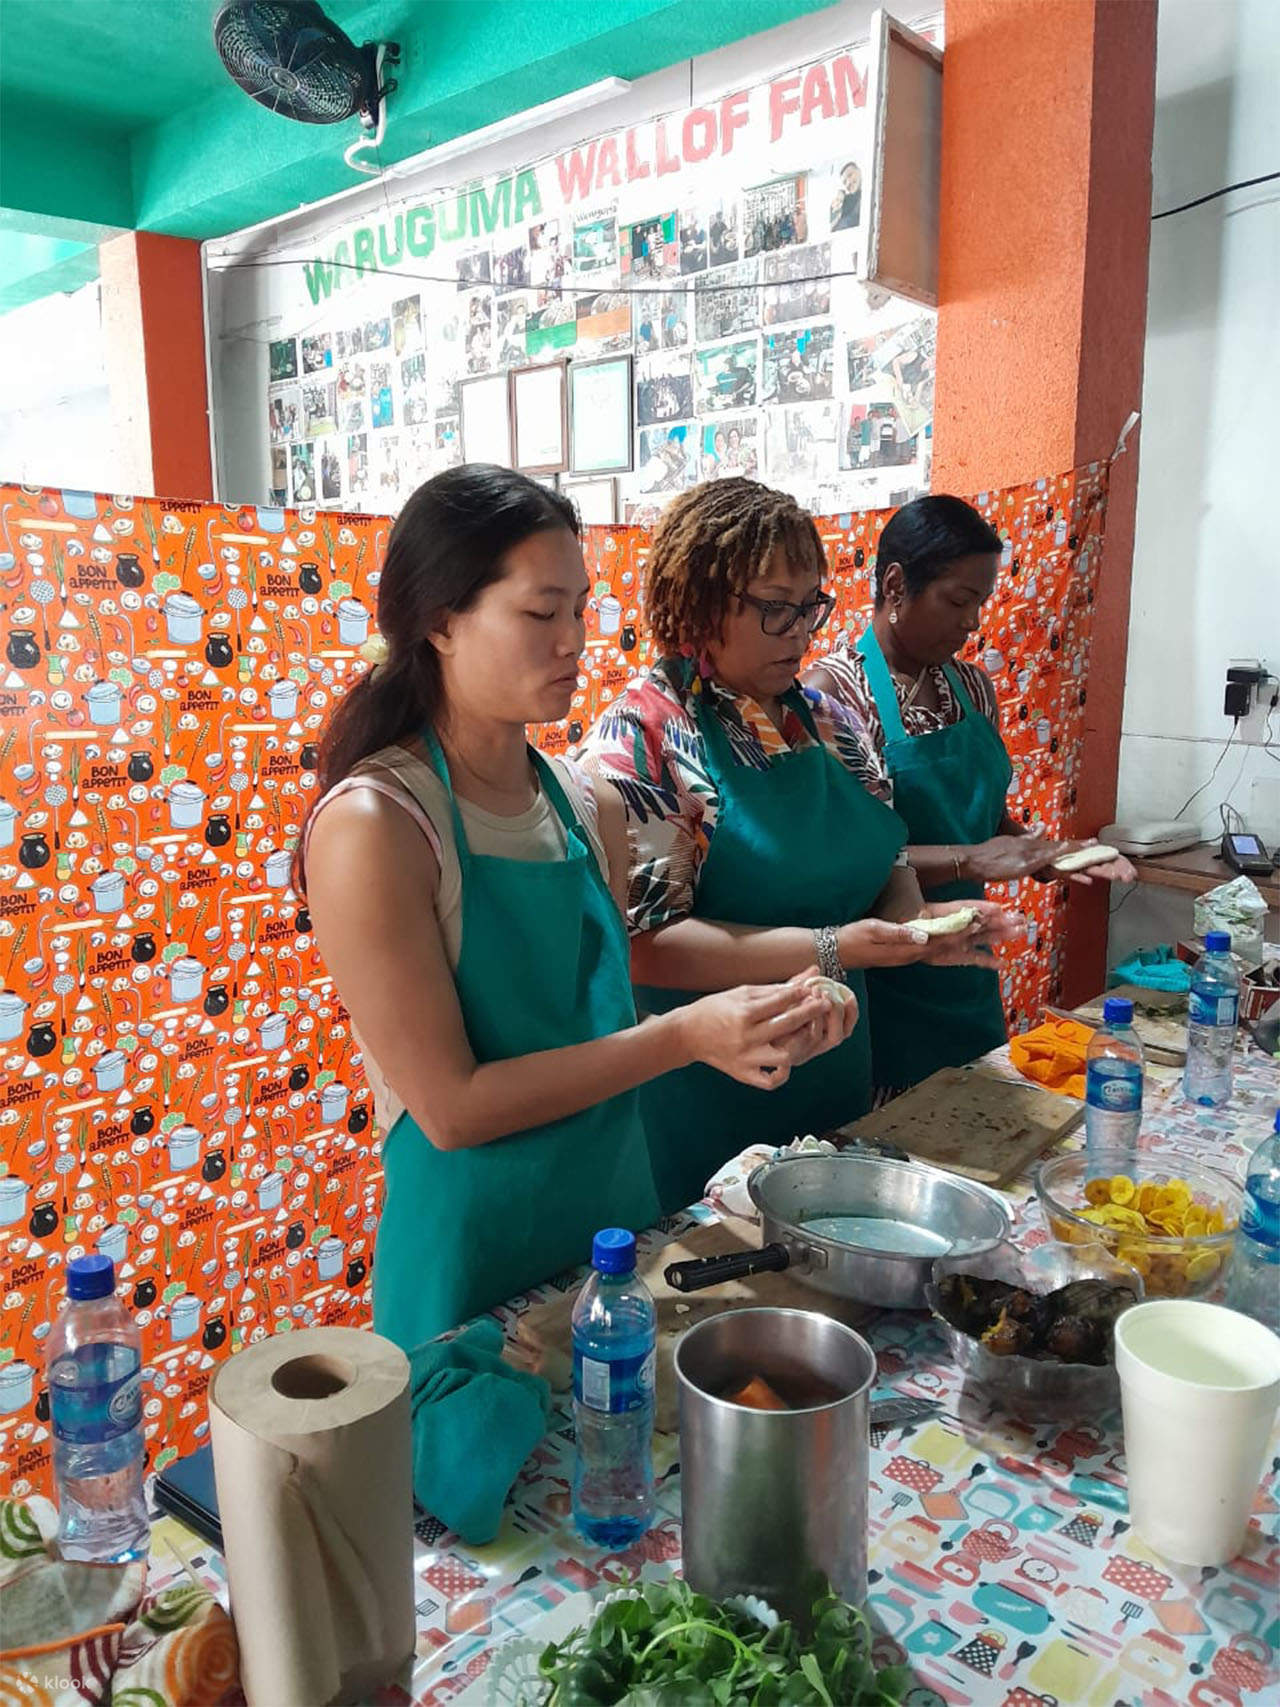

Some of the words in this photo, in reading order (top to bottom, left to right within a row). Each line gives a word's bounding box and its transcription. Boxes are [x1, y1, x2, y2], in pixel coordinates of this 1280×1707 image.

[303, 168, 542, 306] WARUGUMA
[769, 54, 868, 143] FAM
[78, 564, 107, 578] BON
[267, 574, 291, 586] BON
[0, 694, 17, 705] ON
[188, 690, 212, 701] BON
[270, 755, 293, 766] BON
[91, 766, 119, 778] BON
[187, 869, 211, 880] BON
[0, 893, 27, 907] BON
[266, 920, 288, 933] BON
[97, 949, 123, 963] BON
[186, 1039, 208, 1052] BON
[8, 1081, 34, 1096] BON
[261, 1081, 283, 1095] BON
[97, 1124, 123, 1140] BON
[186, 1204, 207, 1219] BON
[259, 1240, 280, 1256] BON
[12, 1262, 37, 1279] BON
[18, 1446, 43, 1466] BON
